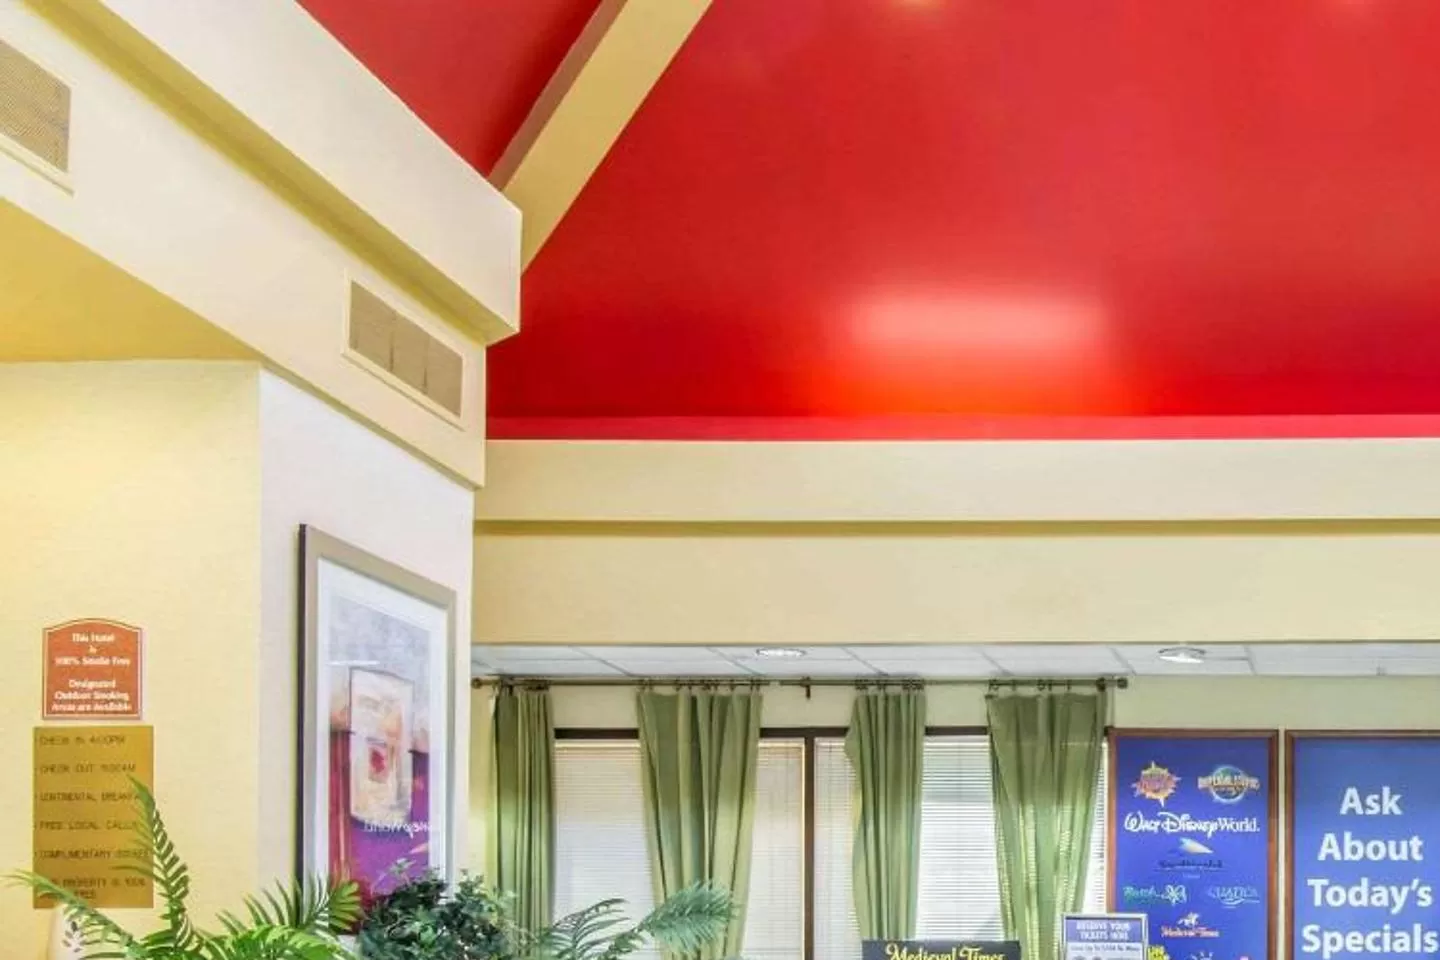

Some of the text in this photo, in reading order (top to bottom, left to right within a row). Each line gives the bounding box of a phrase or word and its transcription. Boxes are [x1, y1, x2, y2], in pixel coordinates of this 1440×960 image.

[54, 691, 129, 701] Outdoor Smoking
[68, 679, 116, 690] Designated
[75, 763, 93, 772] OUT
[1340, 786, 1403, 815] Ask
[1124, 811, 1160, 833] Walt
[1157, 811, 1217, 839] Disney
[1317, 831, 1424, 861] About
[1307, 877, 1433, 915] Today's
[1302, 923, 1439, 960] Specials
